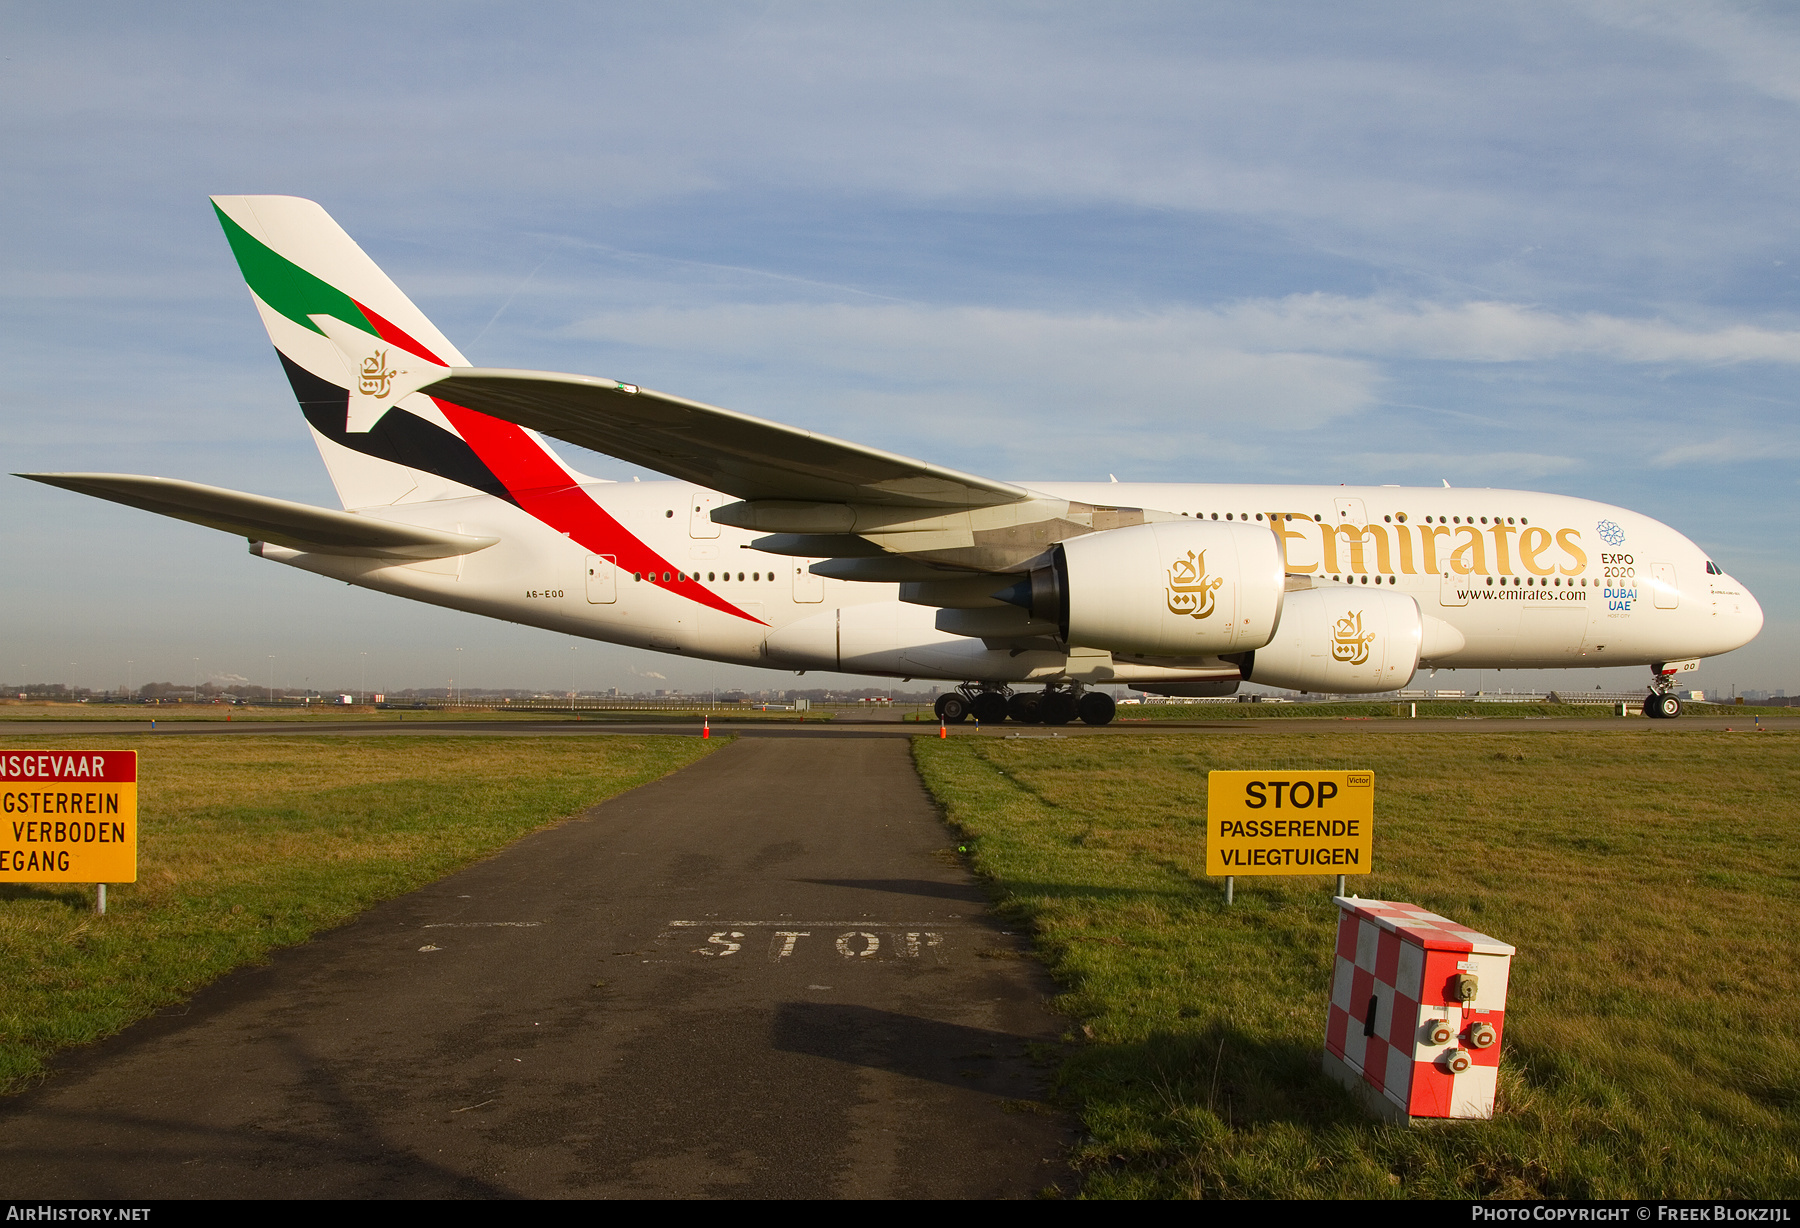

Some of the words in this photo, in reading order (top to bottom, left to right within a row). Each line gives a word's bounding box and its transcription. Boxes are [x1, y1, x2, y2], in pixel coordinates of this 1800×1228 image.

[1264, 511, 1588, 577] Emirates
[1601, 553, 1634, 565] EXPO
[1603, 566, 1636, 578] 2020
[1457, 587, 1586, 601] www.emirates.com
[1603, 588, 1637, 599] DUBAI
[1608, 600, 1631, 611] UAE
[1348, 776, 1369, 785] Victor
[3, 792, 119, 814] GSTERREIN
[1244, 781, 1338, 809] STOP
[12, 821, 125, 843] VERBODEN
[1220, 820, 1360, 838] PASSERENDE
[0, 850, 70, 872] EGANG
[1220, 848, 1360, 866] VLIEGTUIGEN
[699, 931, 945, 958] STOP
